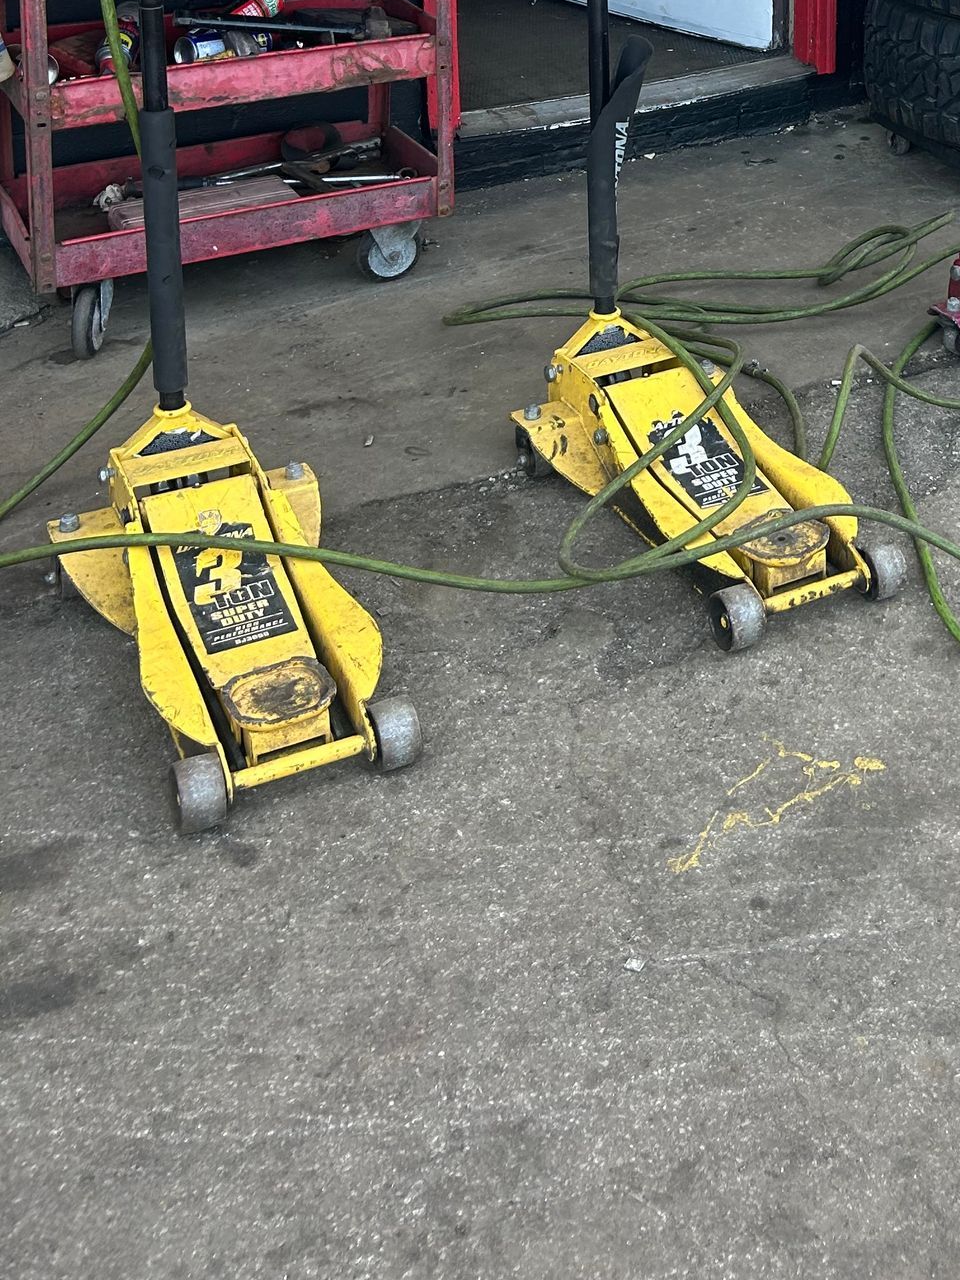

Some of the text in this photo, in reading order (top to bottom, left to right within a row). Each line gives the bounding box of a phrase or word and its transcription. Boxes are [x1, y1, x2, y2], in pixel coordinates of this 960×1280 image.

[686, 452, 740, 477] TON
[691, 468, 739, 487] SUPER
[701, 475, 737, 492] DUTY
[193, 546, 243, 606] 3
[210, 579, 275, 610] TON
[210, 598, 270, 621] SUPER
[220, 608, 265, 627] DUTY
[213, 618, 284, 642] PERFORMANCE
